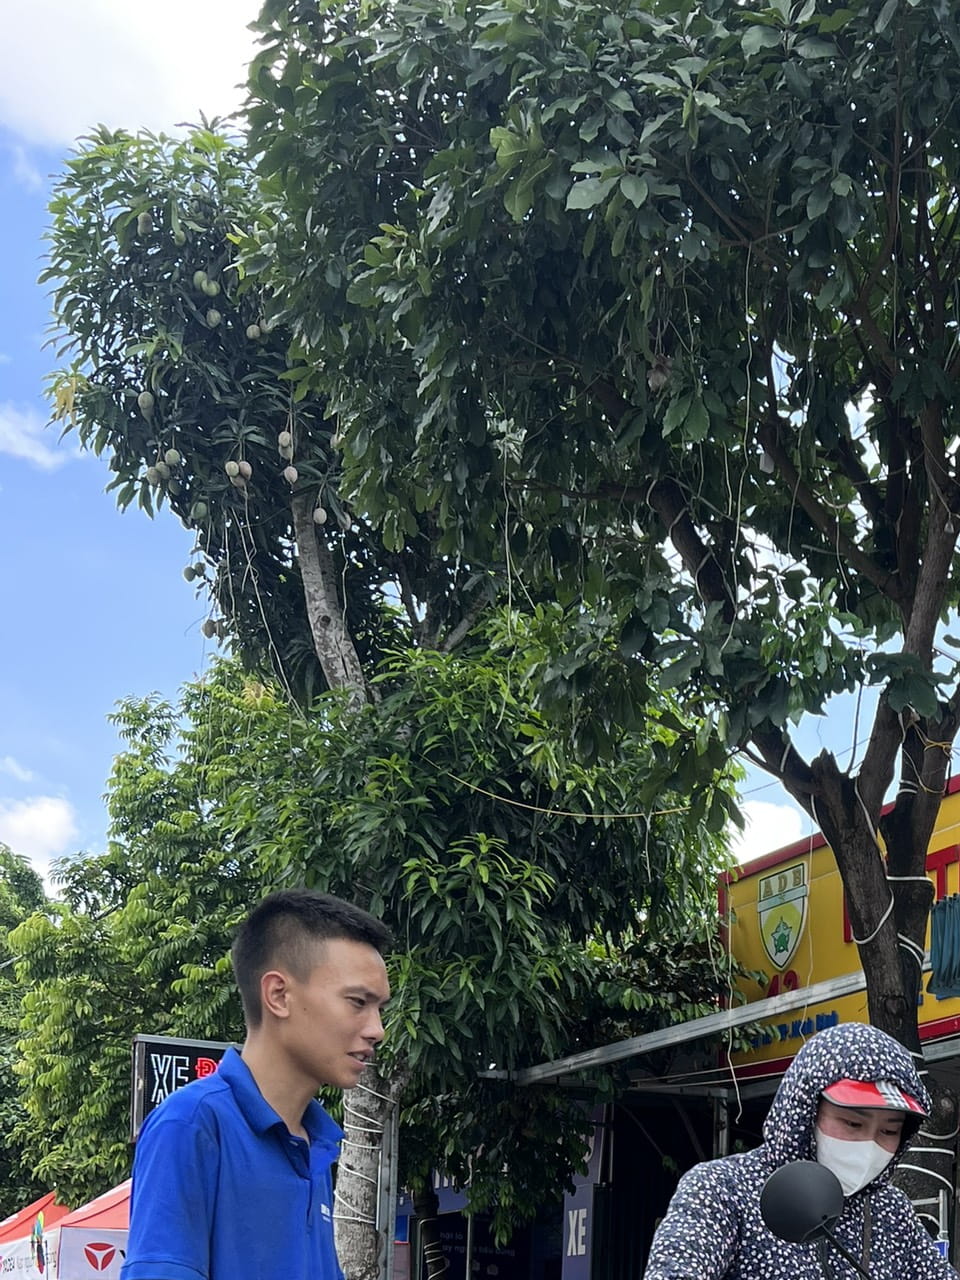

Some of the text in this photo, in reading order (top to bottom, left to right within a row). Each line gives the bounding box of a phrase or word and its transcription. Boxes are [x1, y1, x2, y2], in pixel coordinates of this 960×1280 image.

[150, 1053, 222, 1103] XE Đ
[566, 1208, 588, 1257] XE
